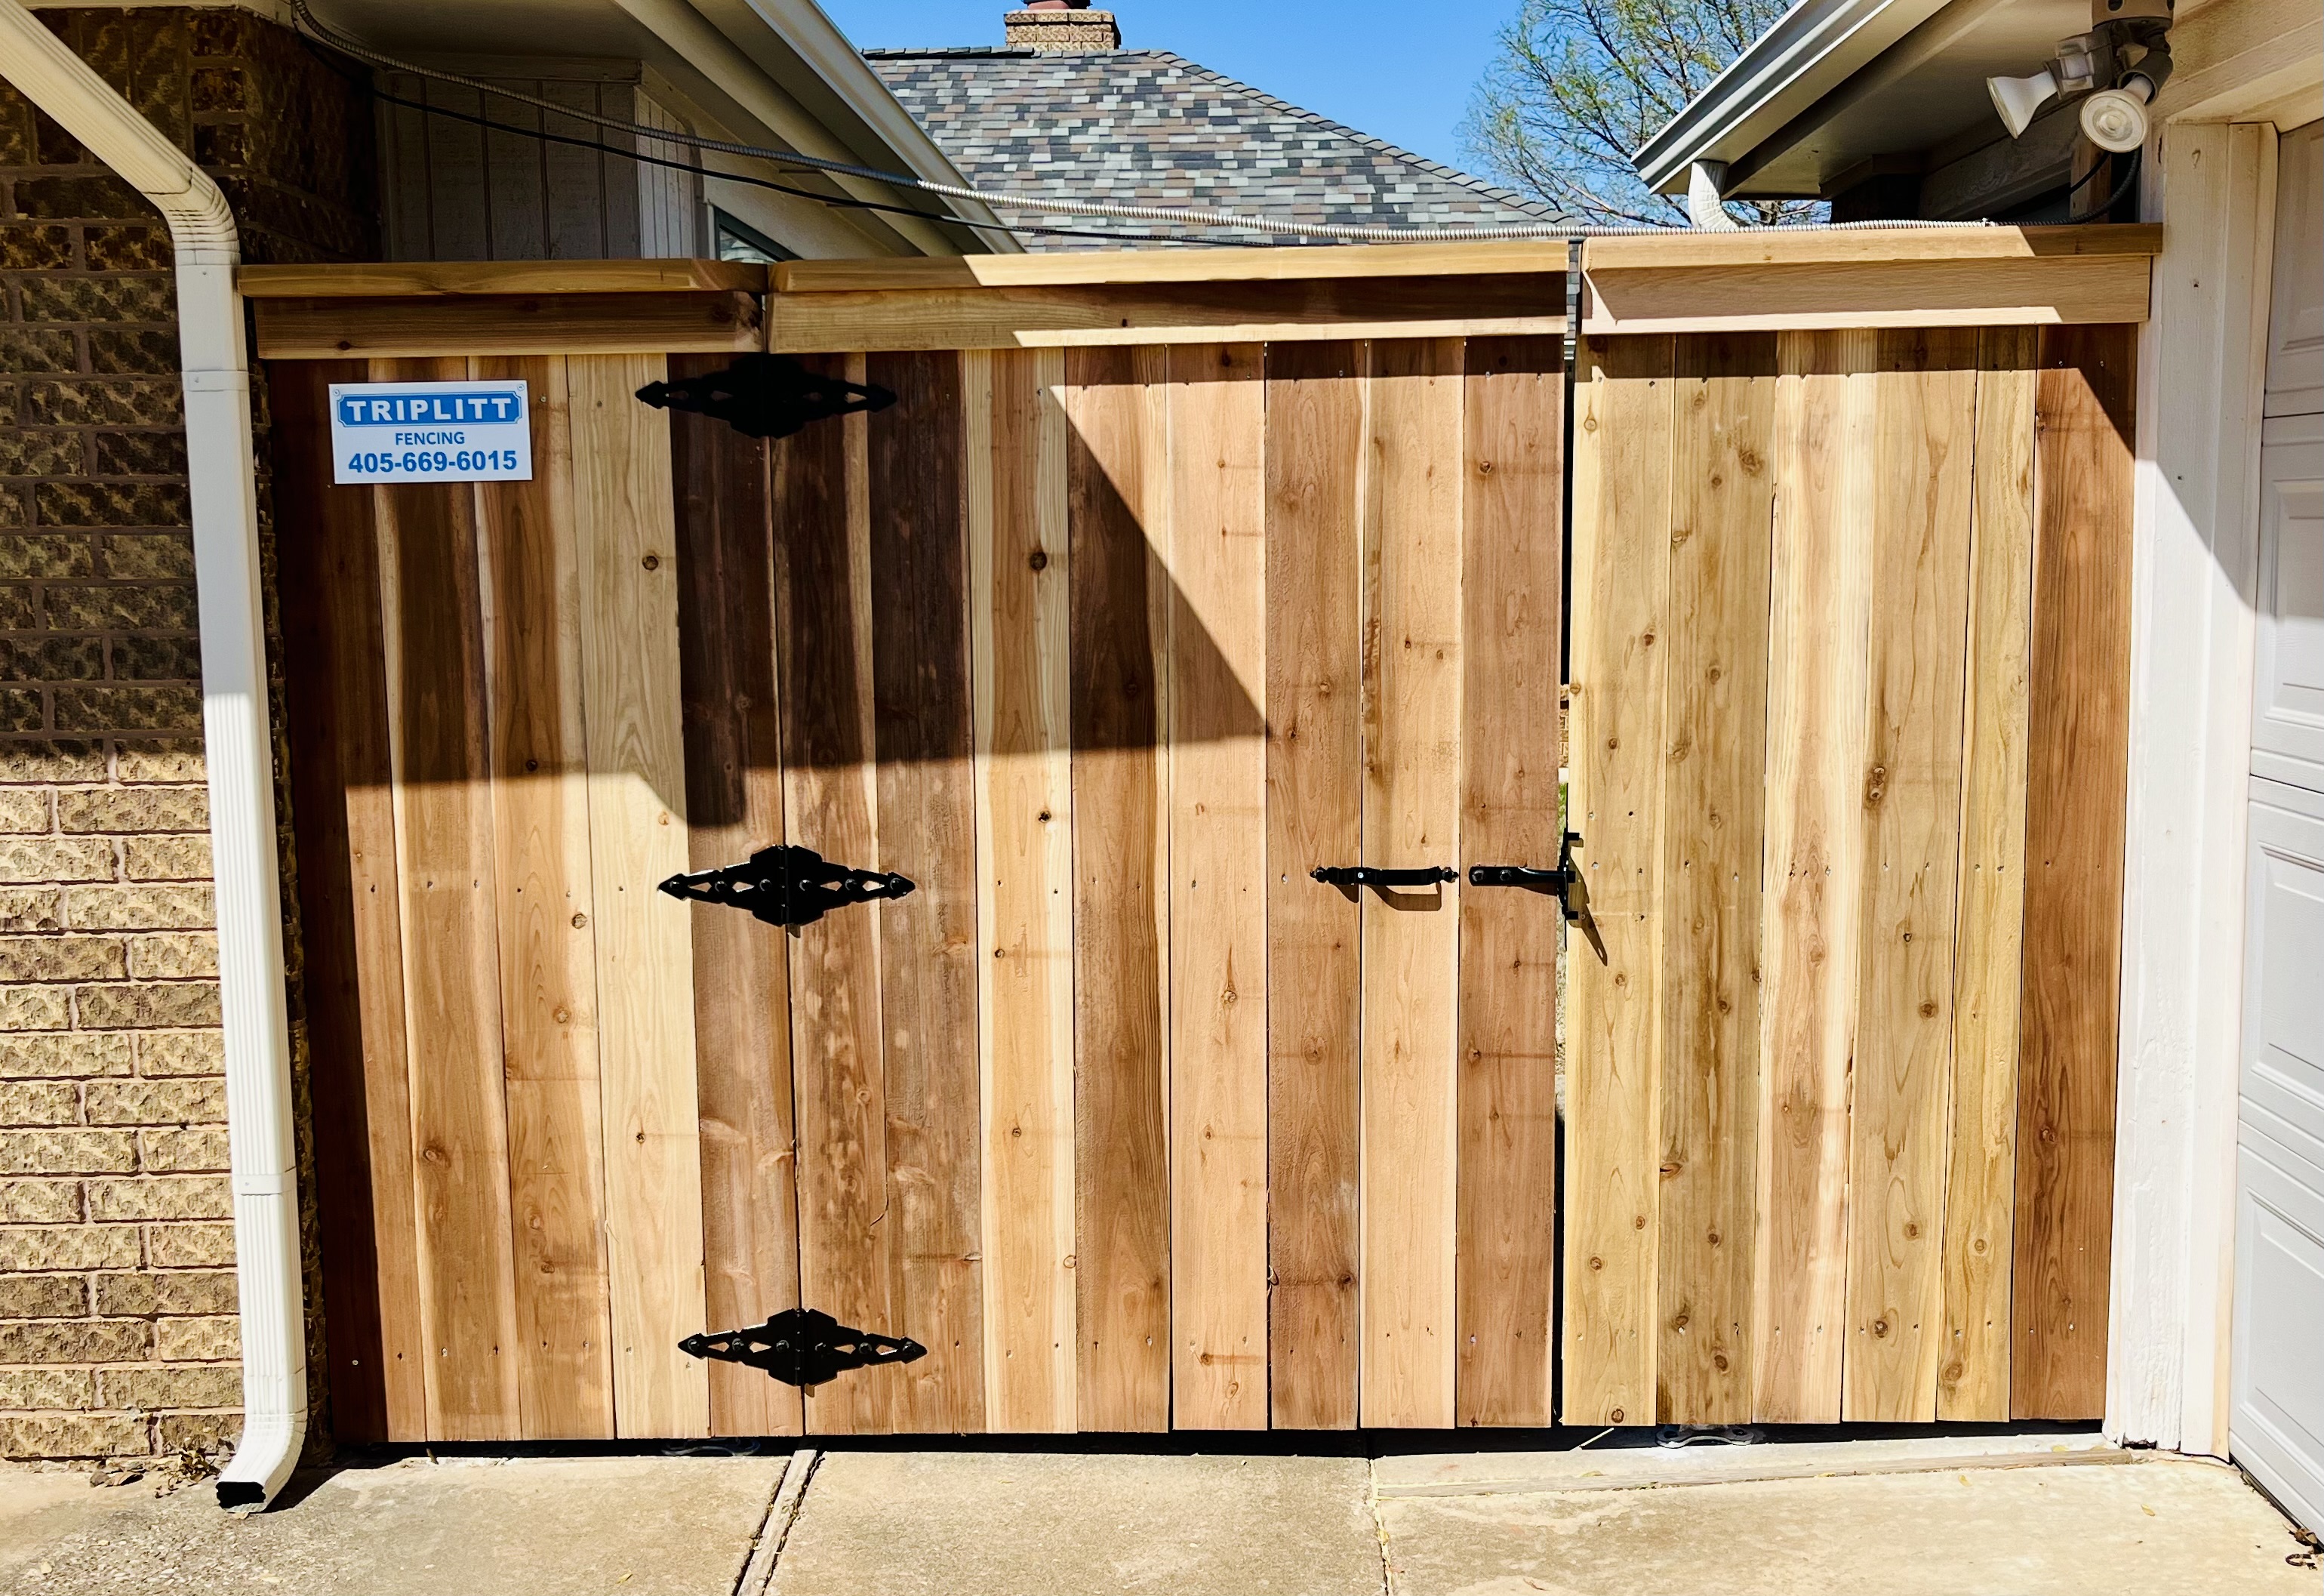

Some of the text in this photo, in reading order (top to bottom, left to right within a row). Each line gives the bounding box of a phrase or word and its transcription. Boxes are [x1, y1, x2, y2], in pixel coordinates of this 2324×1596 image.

[346, 398, 512, 422] TRIPLITT
[396, 431, 465, 445] FENCING
[348, 450, 517, 473] 405-669-6015
